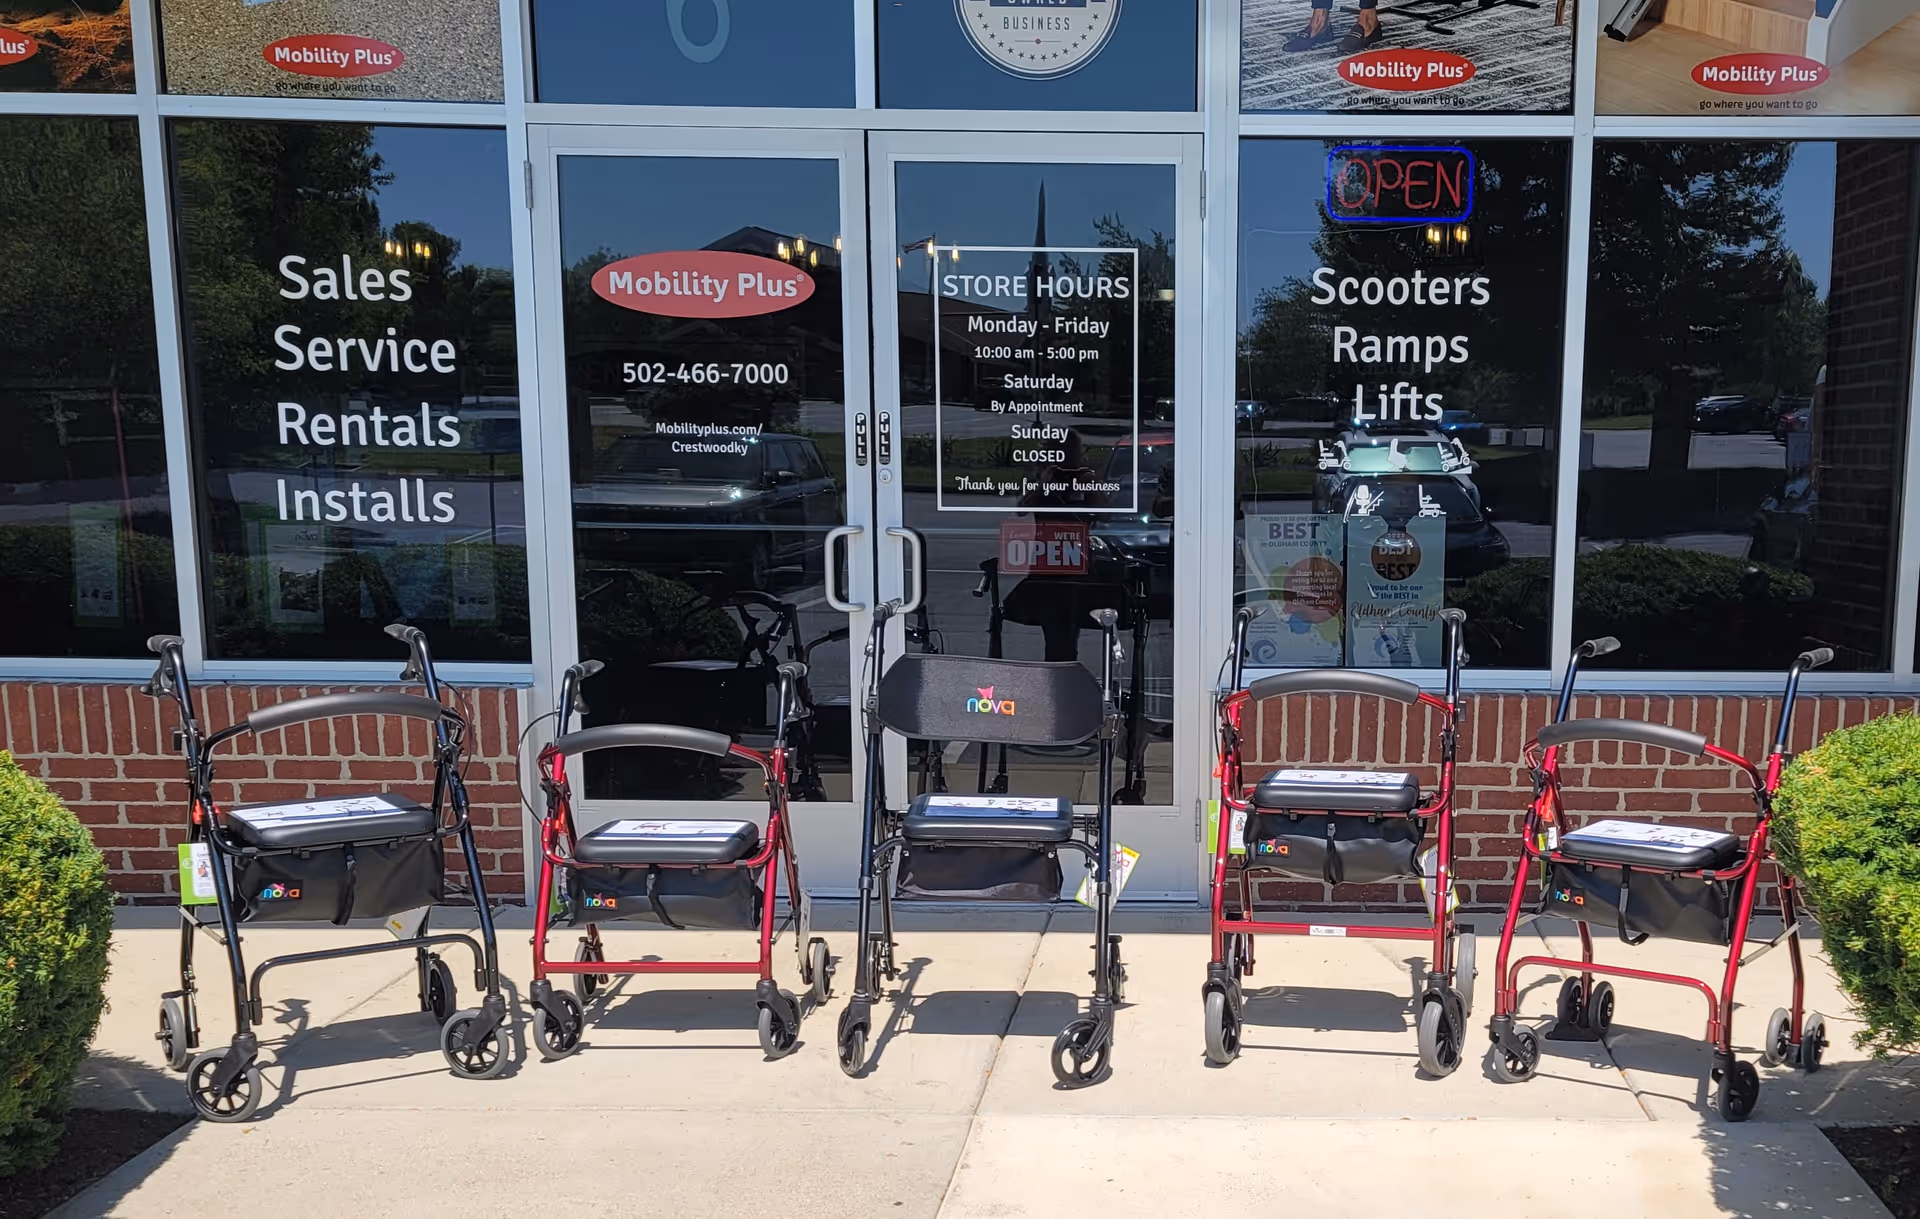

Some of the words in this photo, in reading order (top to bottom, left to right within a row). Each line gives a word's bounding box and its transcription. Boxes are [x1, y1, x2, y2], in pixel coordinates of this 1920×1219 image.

[1003, 16, 1070, 30] BUSINESS
[0, 38, 26, 54] lus
[274, 47, 349, 68] Mobility
[1349, 61, 1422, 82] Mobility
[1703, 66, 1776, 85] Mobility
[275, 82, 287, 91] go
[290, 82, 320, 91] where
[322, 83, 342, 92] you
[344, 83, 367, 92] want
[368, 83, 381, 92] to
[384, 85, 397, 94] go
[1361, 96, 1390, 105] where
[1392, 97, 1411, 106] you
[1413, 96, 1438, 105] want
[1439, 96, 1450, 105] to
[1453, 97, 1465, 106] go
[1699, 100, 1711, 110] go
[1713, 100, 1743, 108] where
[1745, 101, 1764, 110] you
[1766, 100, 1791, 108] want
[1792, 100, 1803, 109] to
[1805, 101, 1818, 110] go
[1336, 158, 1465, 210] OPEN
[278, 253, 413, 302] Sales
[608, 271, 729, 303] Mobility
[942, 274, 1028, 297] STORE
[1036, 276, 1130, 298] HOURS
[1310, 267, 1490, 306] Scooters
[967, 315, 1038, 337] Monday
[1054, 316, 1110, 338] Friday
[274, 324, 456, 373] Service
[974, 346, 1011, 359] 10:00
[1014, 348, 1034, 359] am
[1046, 347, 1075, 360] 5:00
[1078, 349, 1099, 362] pm
[1333, 325, 1469, 373] Ramps
[623, 362, 789, 384] 502-466-7000
[1003, 373, 1074, 393] Saturday
[991, 400, 1006, 414] By
[1008, 400, 1084, 414] Appointment
[1355, 381, 1444, 421] Lifts
[277, 402, 461, 448] Rentals
[655, 422, 763, 437] Mobilityplus.com/
[880, 413, 889, 455] PULL
[1011, 424, 1069, 443] Sunday
[856, 414, 866, 457] PULL
[671, 441, 748, 456] Crestwoodky
[1012, 450, 1066, 463] CLOSED
[955, 476, 995, 491] Thank
[997, 482, 1020, 495] you
[1022, 476, 1039, 495] for
[1042, 481, 1069, 495] your
[1072, 478, 1120, 491] business
[276, 477, 456, 523] Installs
[1269, 522, 1320, 539] BEST
[1007, 539, 1081, 566] OPEN
[966, 697, 1016, 716] nova
[1260, 843, 1288, 855] nova
[586, 897, 616, 908] nova
